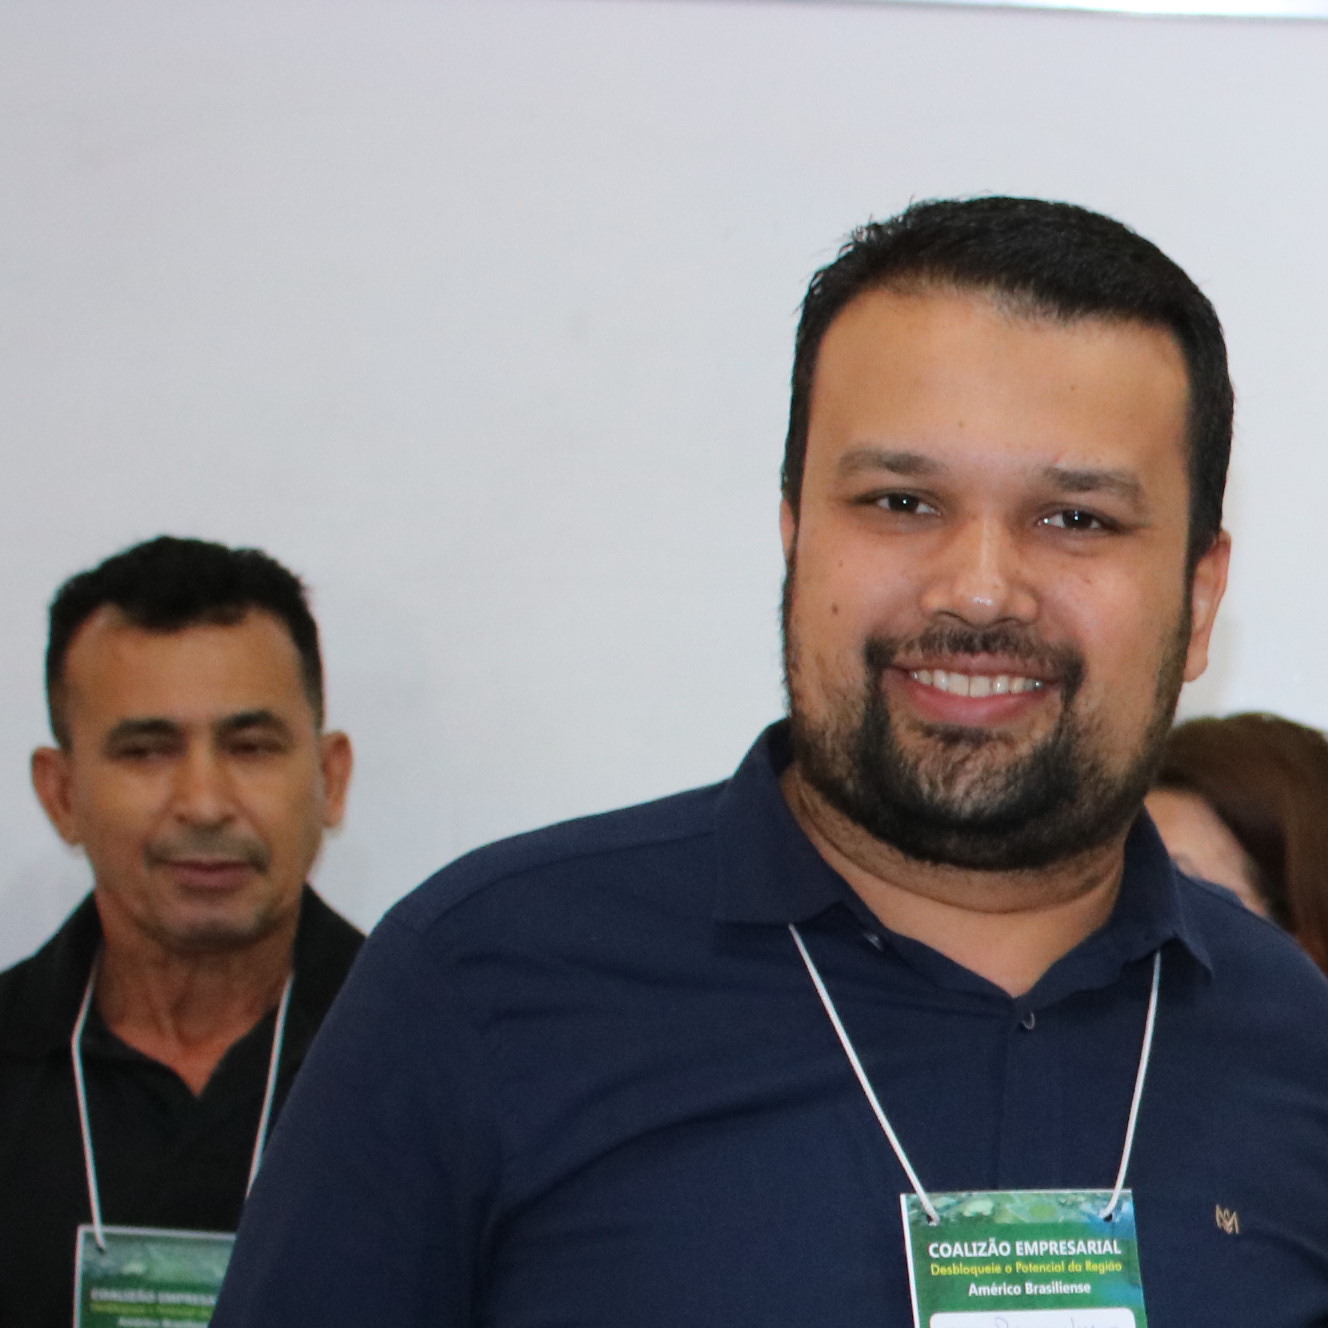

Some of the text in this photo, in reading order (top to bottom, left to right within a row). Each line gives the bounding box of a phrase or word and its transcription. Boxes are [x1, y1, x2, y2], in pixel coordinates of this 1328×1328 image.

[928, 1238, 1122, 1258] COALIZÃO EMPRESARIAL
[930, 1261, 1002, 1277] Desbloqueie
[1005, 1265, 1012, 1274] o
[1015, 1261, 1065, 1273] Potencial
[1085, 1260, 1122, 1275] Região
[968, 1280, 1091, 1296] Américo Brasiliense
